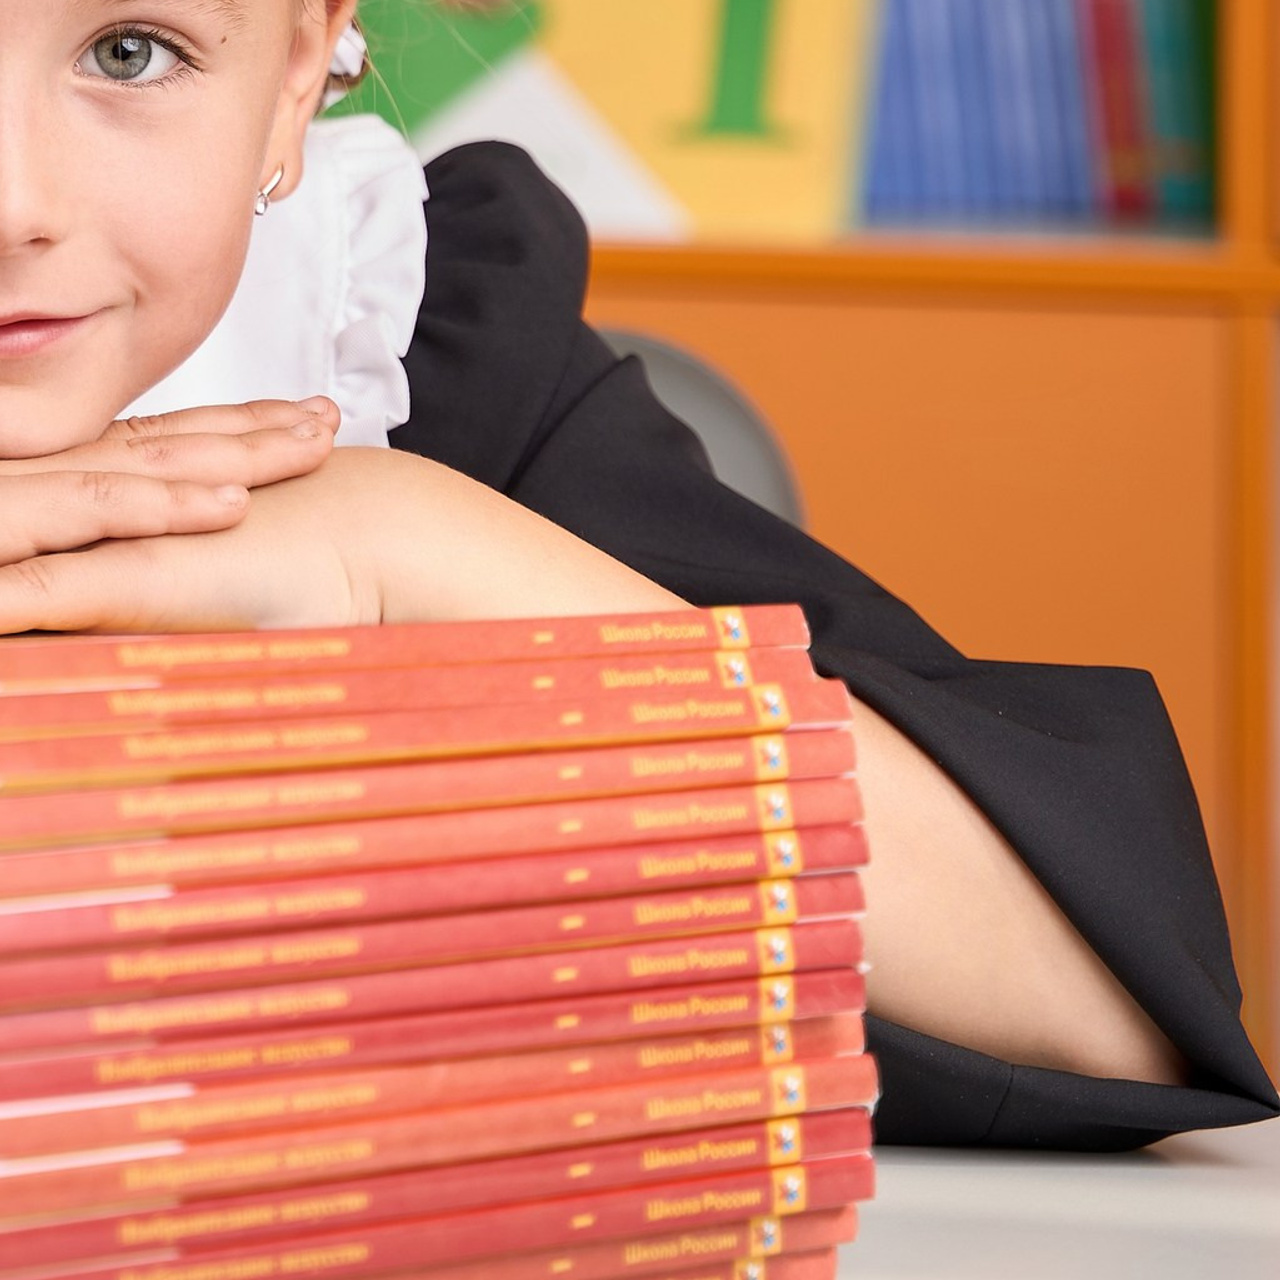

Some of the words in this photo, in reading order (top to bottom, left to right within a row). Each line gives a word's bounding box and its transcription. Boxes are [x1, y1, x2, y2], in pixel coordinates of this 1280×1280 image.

[600, 625, 651, 643] Школа
[652, 622, 707, 640] России
[647, 1199, 702, 1220] Школа
[703, 1191, 761, 1209] России
[625, 1242, 679, 1263] Школа
[680, 1234, 738, 1252] России
